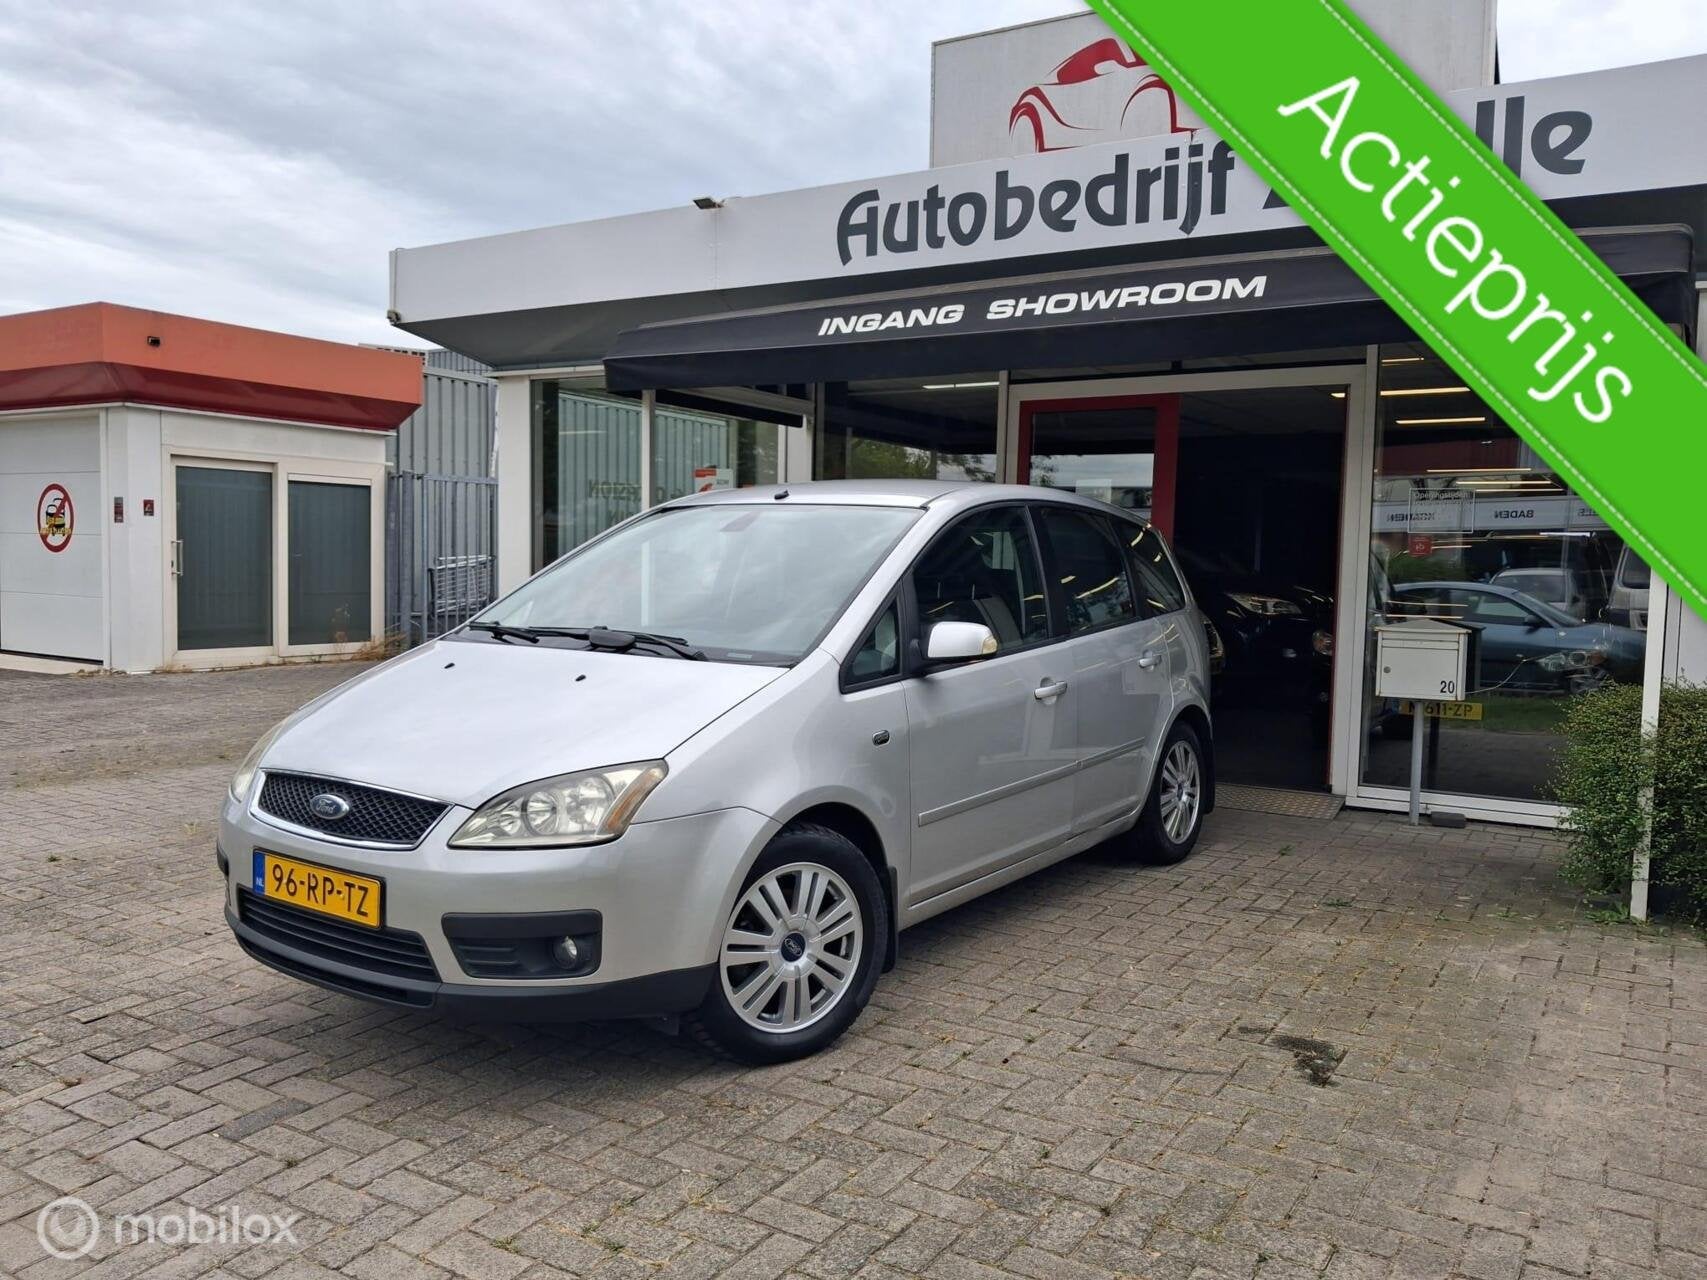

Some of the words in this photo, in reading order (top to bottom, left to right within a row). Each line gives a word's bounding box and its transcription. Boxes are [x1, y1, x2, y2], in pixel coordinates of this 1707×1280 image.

[836, 140, 1235, 267] Autobedrijf
[818, 303, 965, 337] INGANG
[987, 276, 1267, 321] SHOWROOM
[1440, 680, 1455, 694] 20
[272, 863, 369, 918] 96-RP-TZ
